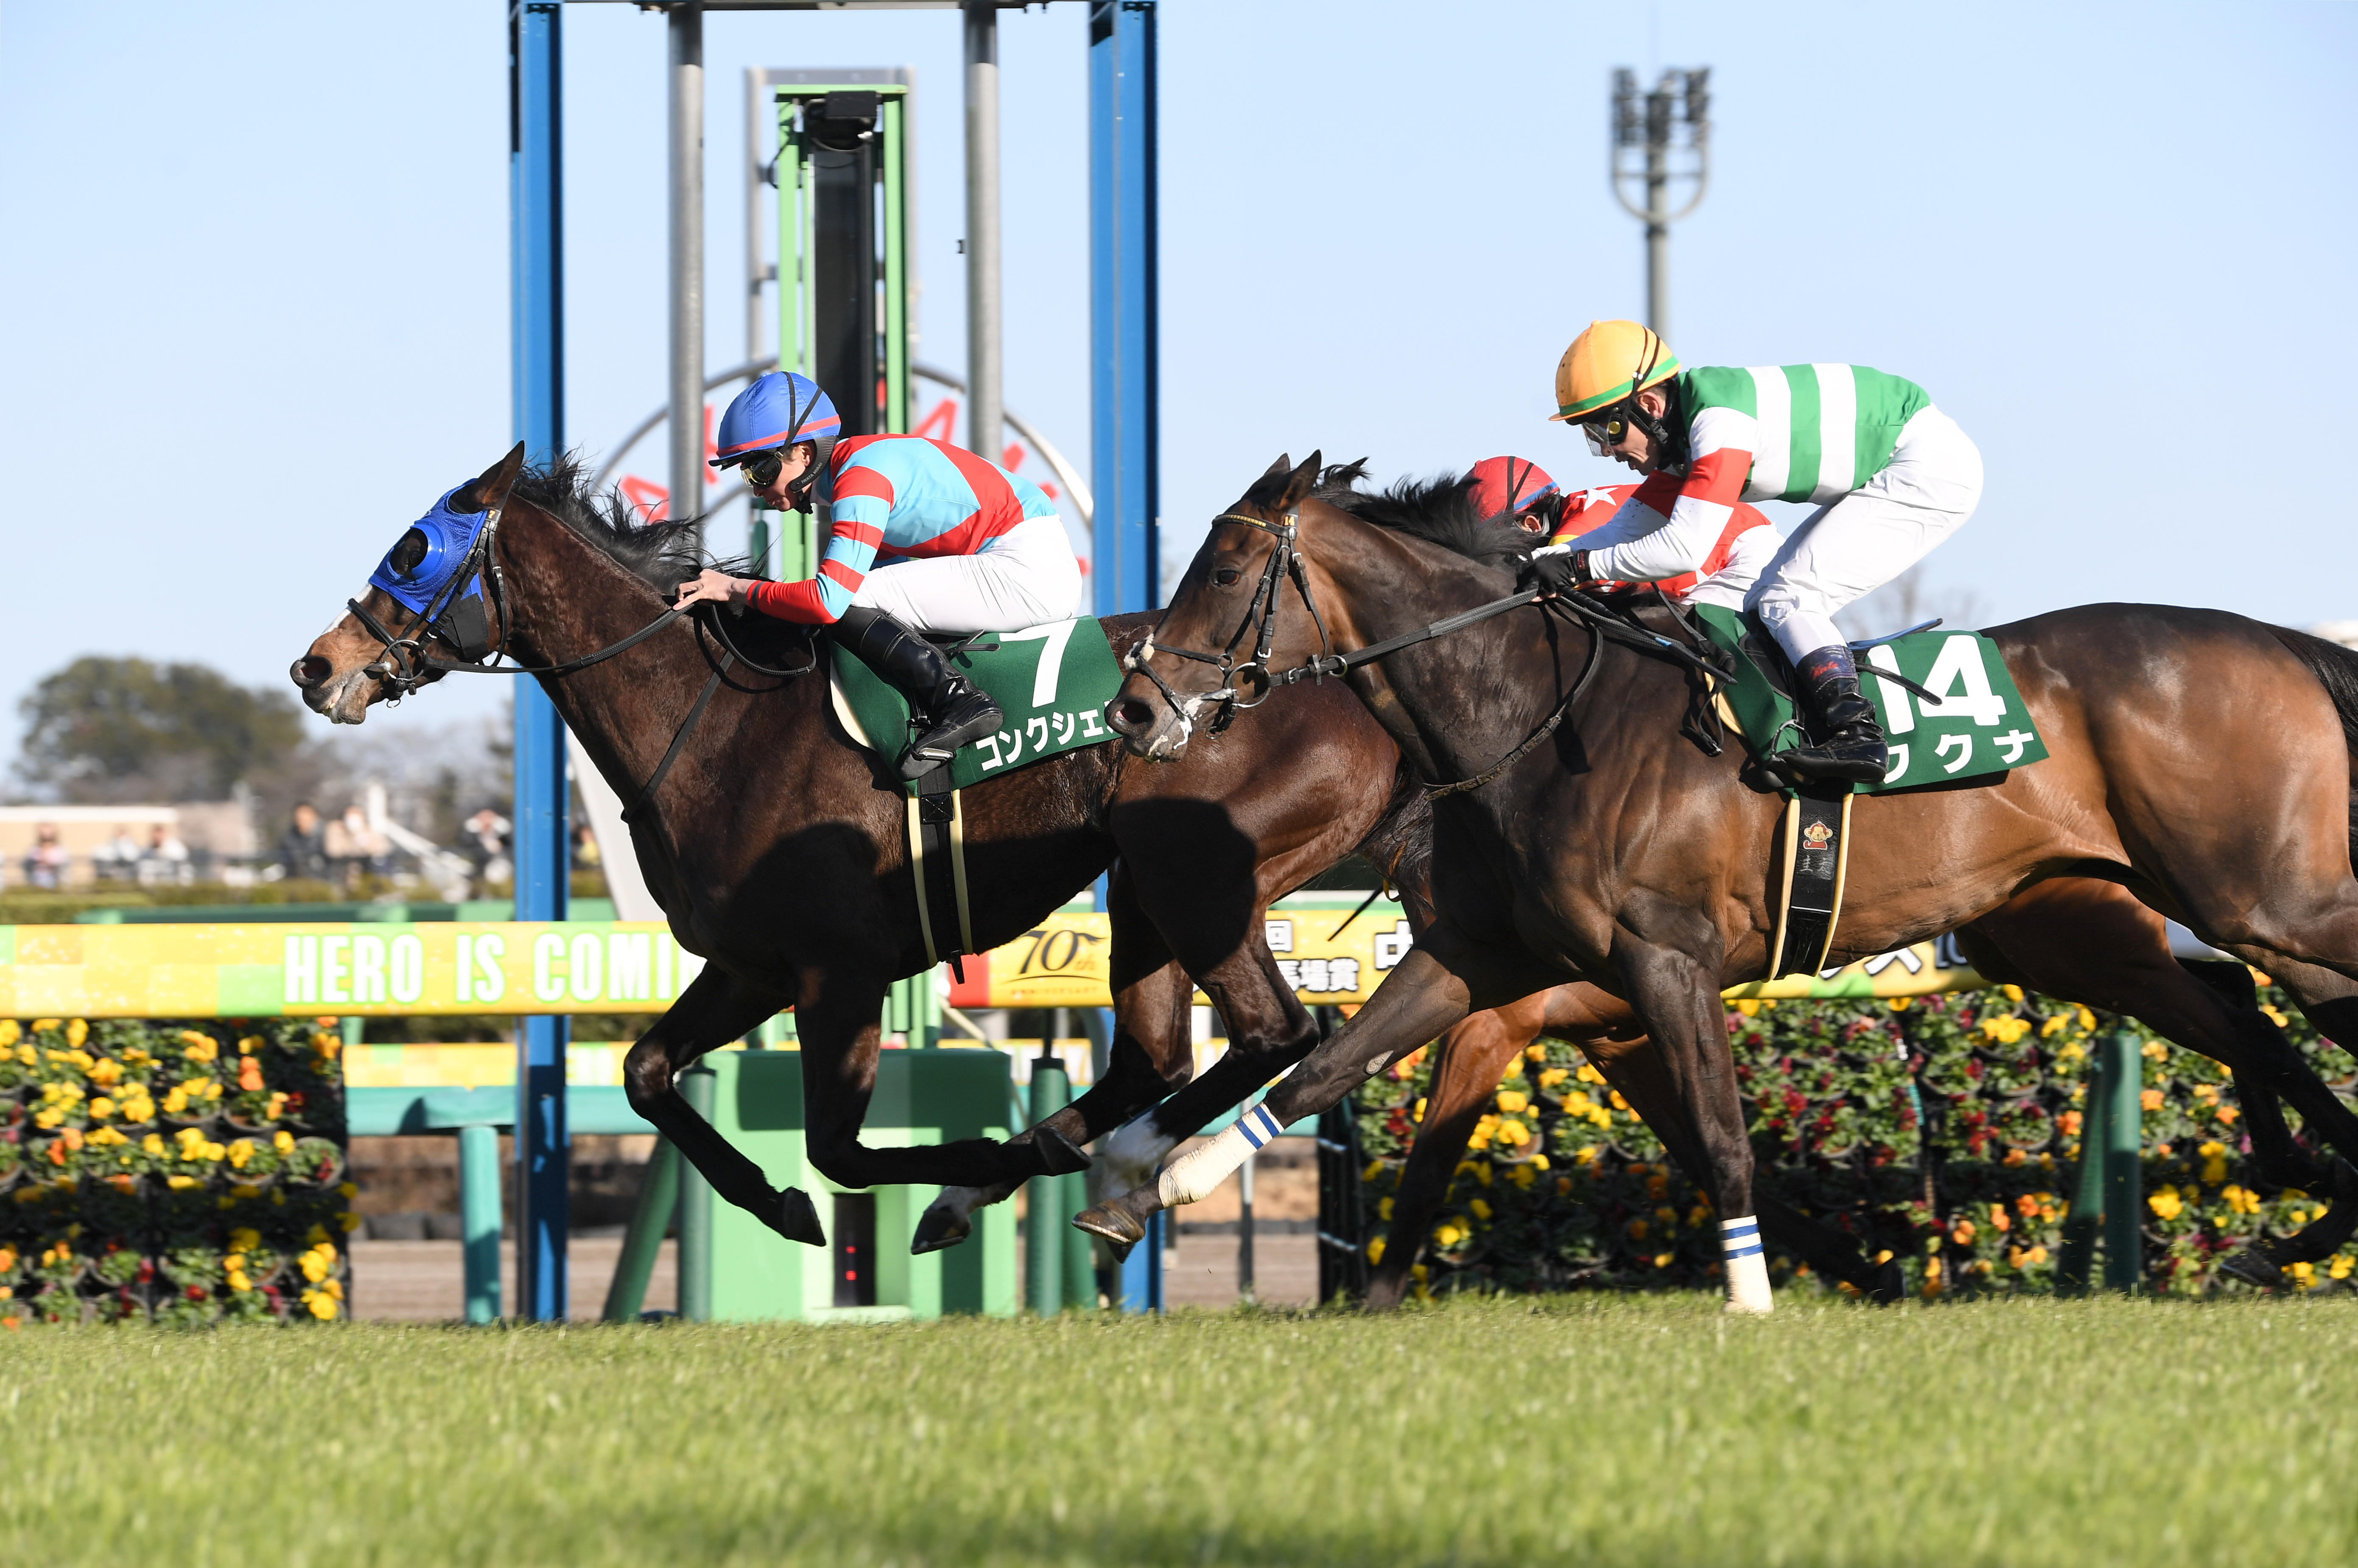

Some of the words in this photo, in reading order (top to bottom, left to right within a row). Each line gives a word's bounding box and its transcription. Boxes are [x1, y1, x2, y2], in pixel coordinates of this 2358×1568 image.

[801, 474, 814, 484] IWATA
[488, 510, 496, 519] 7
[1284, 516, 1295, 526] 14
[999, 618, 1078, 708] 7
[1867, 634, 2007, 735] 14
[976, 699, 1114, 771] コンクシェ
[285, 933, 423, 1003] HERO
[456, 933, 506, 1003] IS
